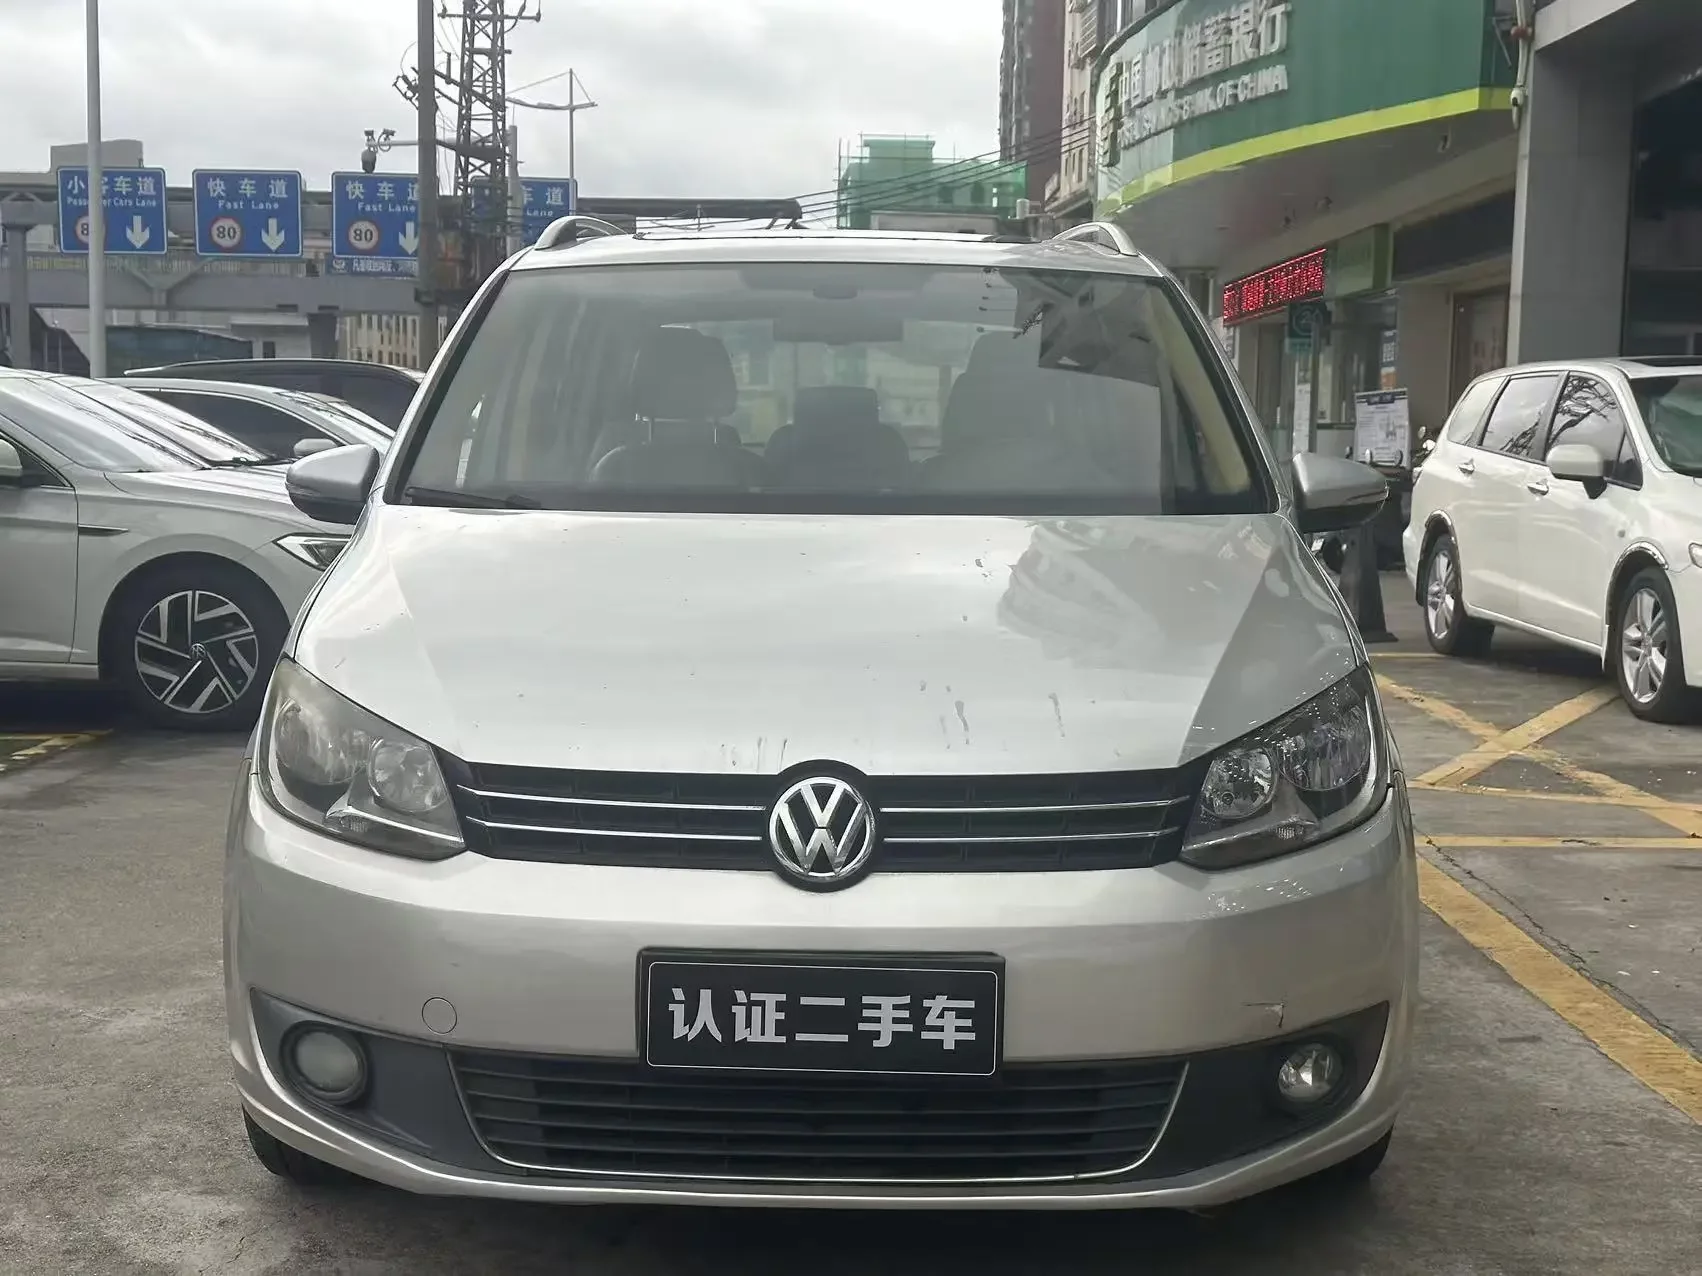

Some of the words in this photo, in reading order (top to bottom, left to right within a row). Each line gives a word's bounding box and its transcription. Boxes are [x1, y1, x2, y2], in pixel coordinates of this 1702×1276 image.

[208, 178, 288, 198] 快车道
[113, 197, 132, 207] Cars
[136, 198, 156, 207] Lane
[218, 200, 244, 209] Fast
[252, 200, 279, 209] Lane
[358, 202, 382, 212] Fast
[389, 203, 416, 213] Lane
[527, 208, 553, 216] Lane
[216, 226, 238, 240] 80
[353, 229, 374, 243] 80
[669, 987, 976, 1050] 认证二手车
